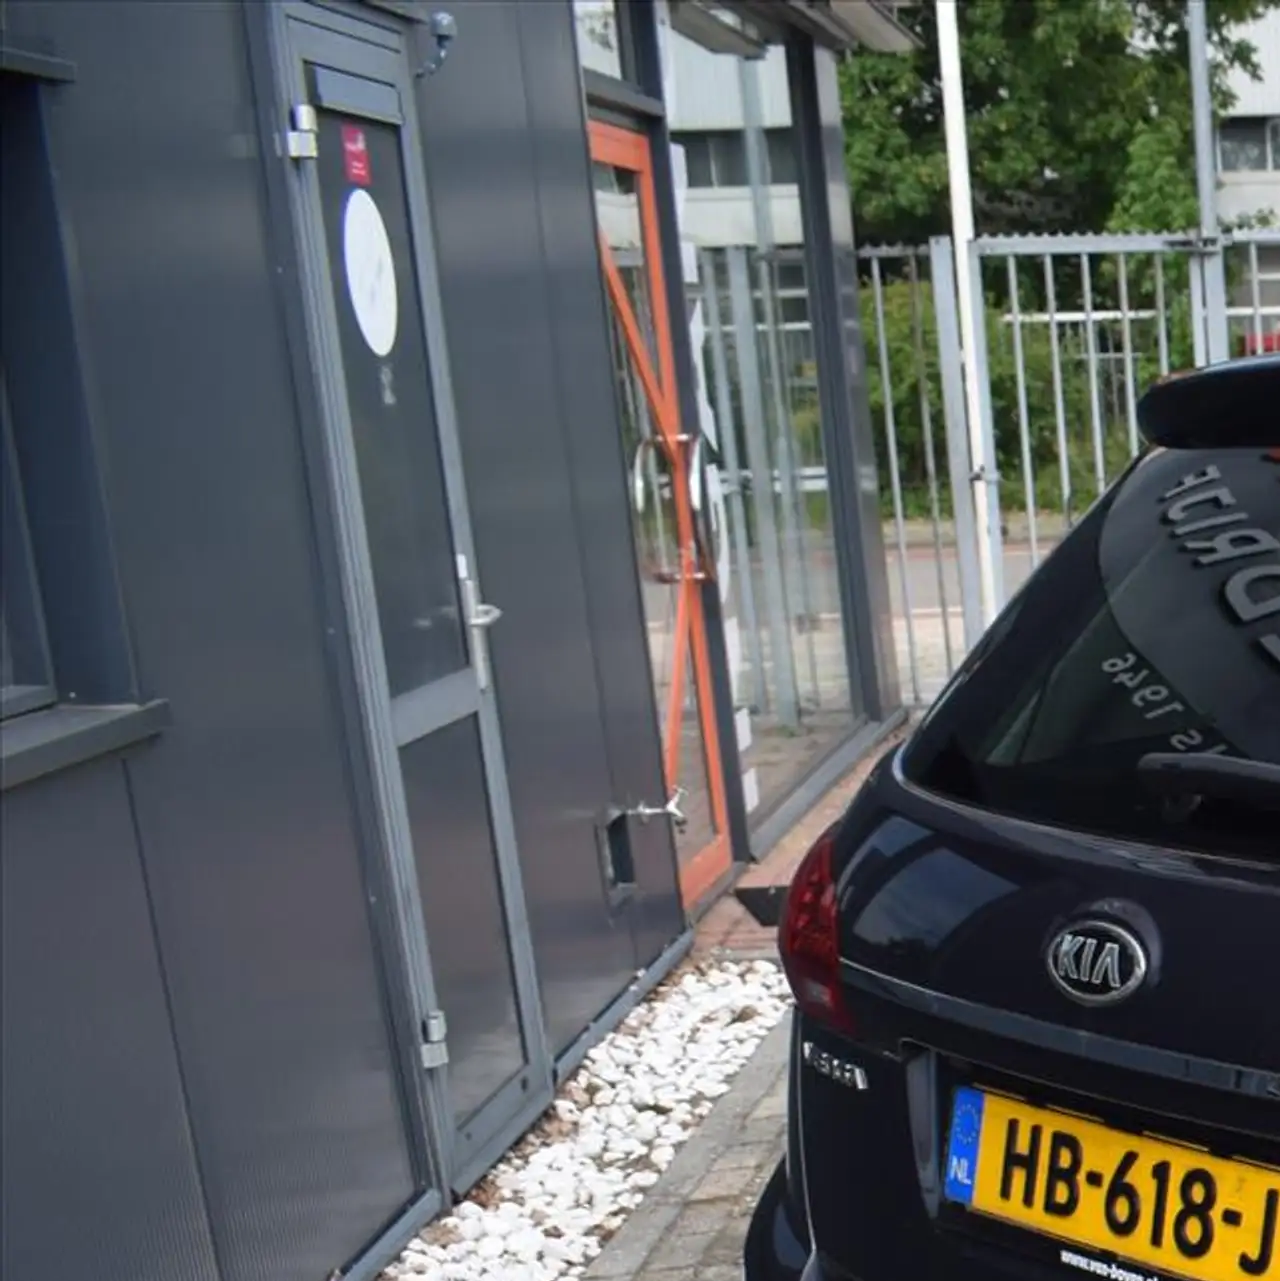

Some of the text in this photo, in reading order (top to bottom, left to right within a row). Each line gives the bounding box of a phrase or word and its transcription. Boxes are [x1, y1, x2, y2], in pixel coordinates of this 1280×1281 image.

[1058, 934, 1121, 988] KIA
[950, 1154, 972, 1185] NL
[1000, 1117, 1278, 1277] HB-618-J
